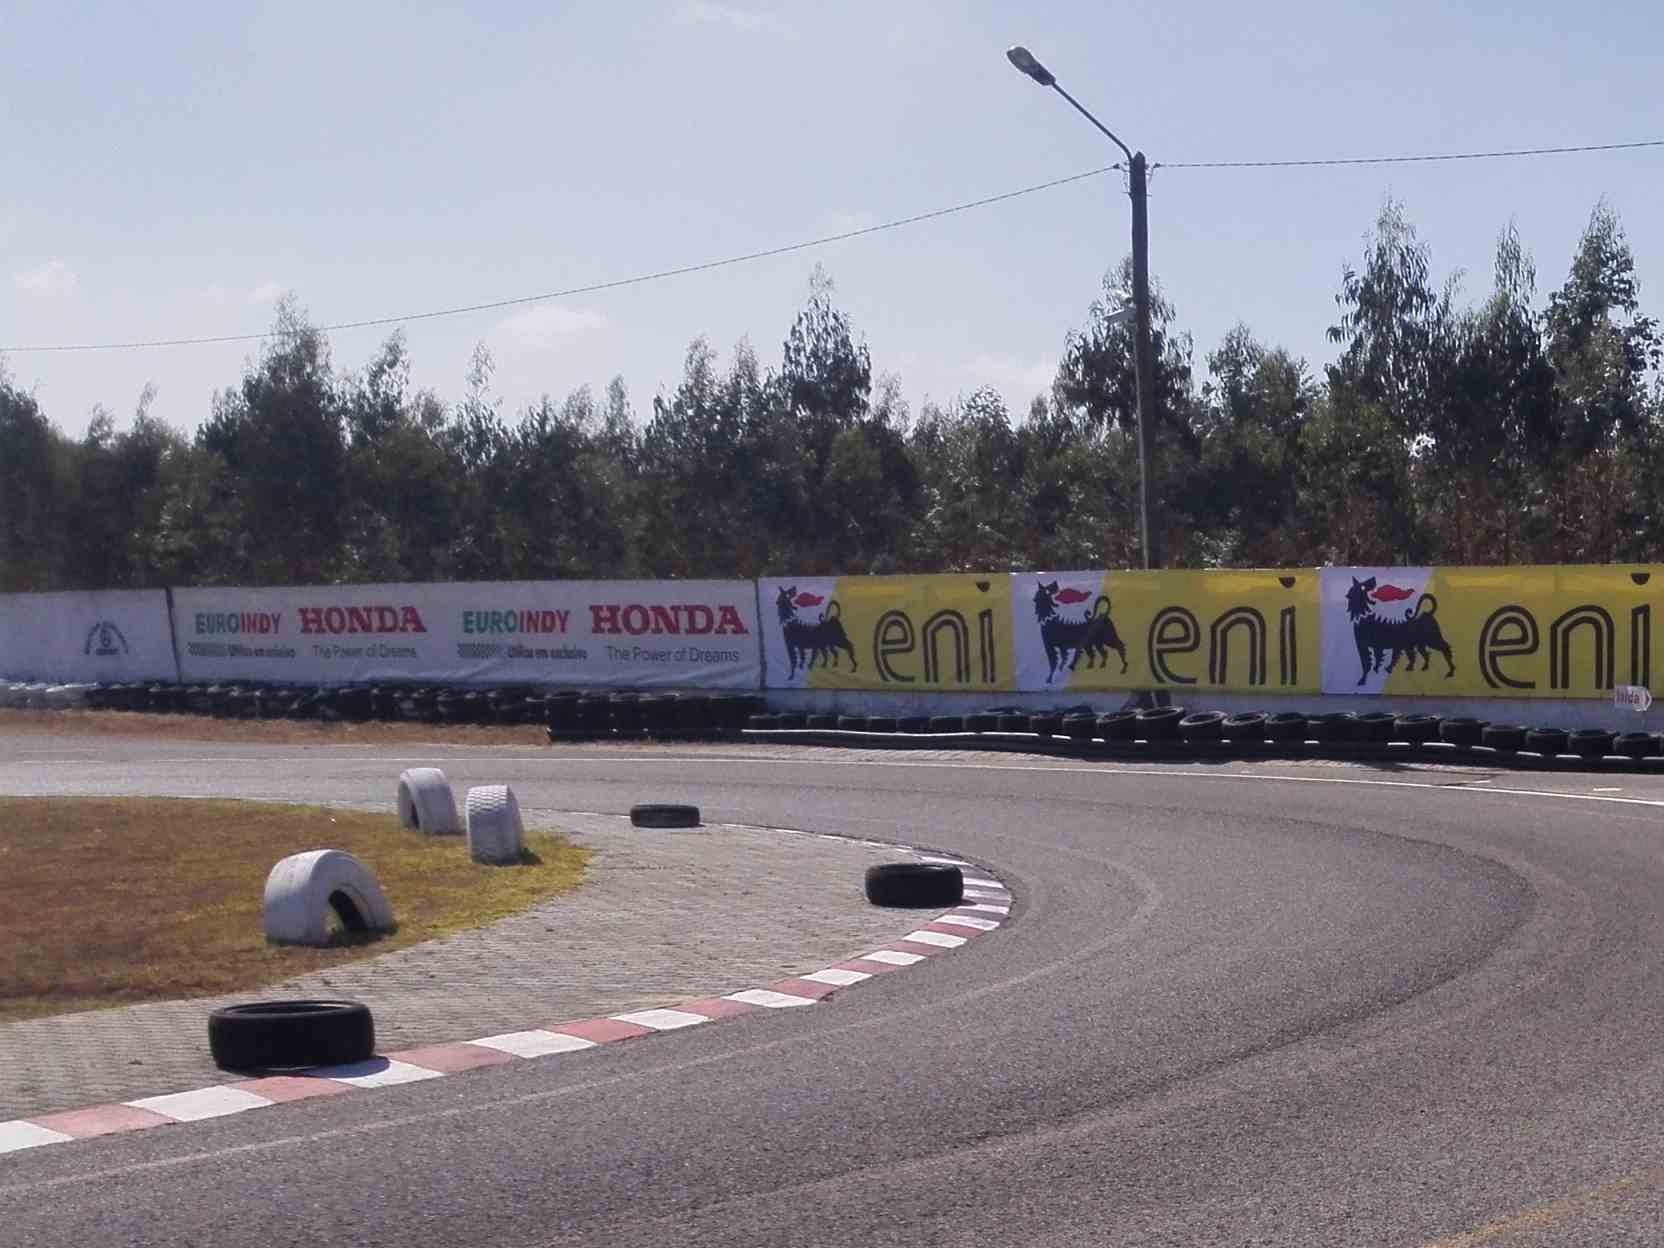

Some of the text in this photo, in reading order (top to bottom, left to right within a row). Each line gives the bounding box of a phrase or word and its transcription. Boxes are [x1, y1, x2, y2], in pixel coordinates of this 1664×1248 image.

[195, 606, 428, 634] EUROINDY HONDA
[463, 604, 749, 636] EUROINDY HONDA
[607, 645, 740, 663] The Power of Dreams
[874, 581, 998, 685] eni
[1148, 576, 1297, 687] eni
[1479, 573, 1651, 690] eni
